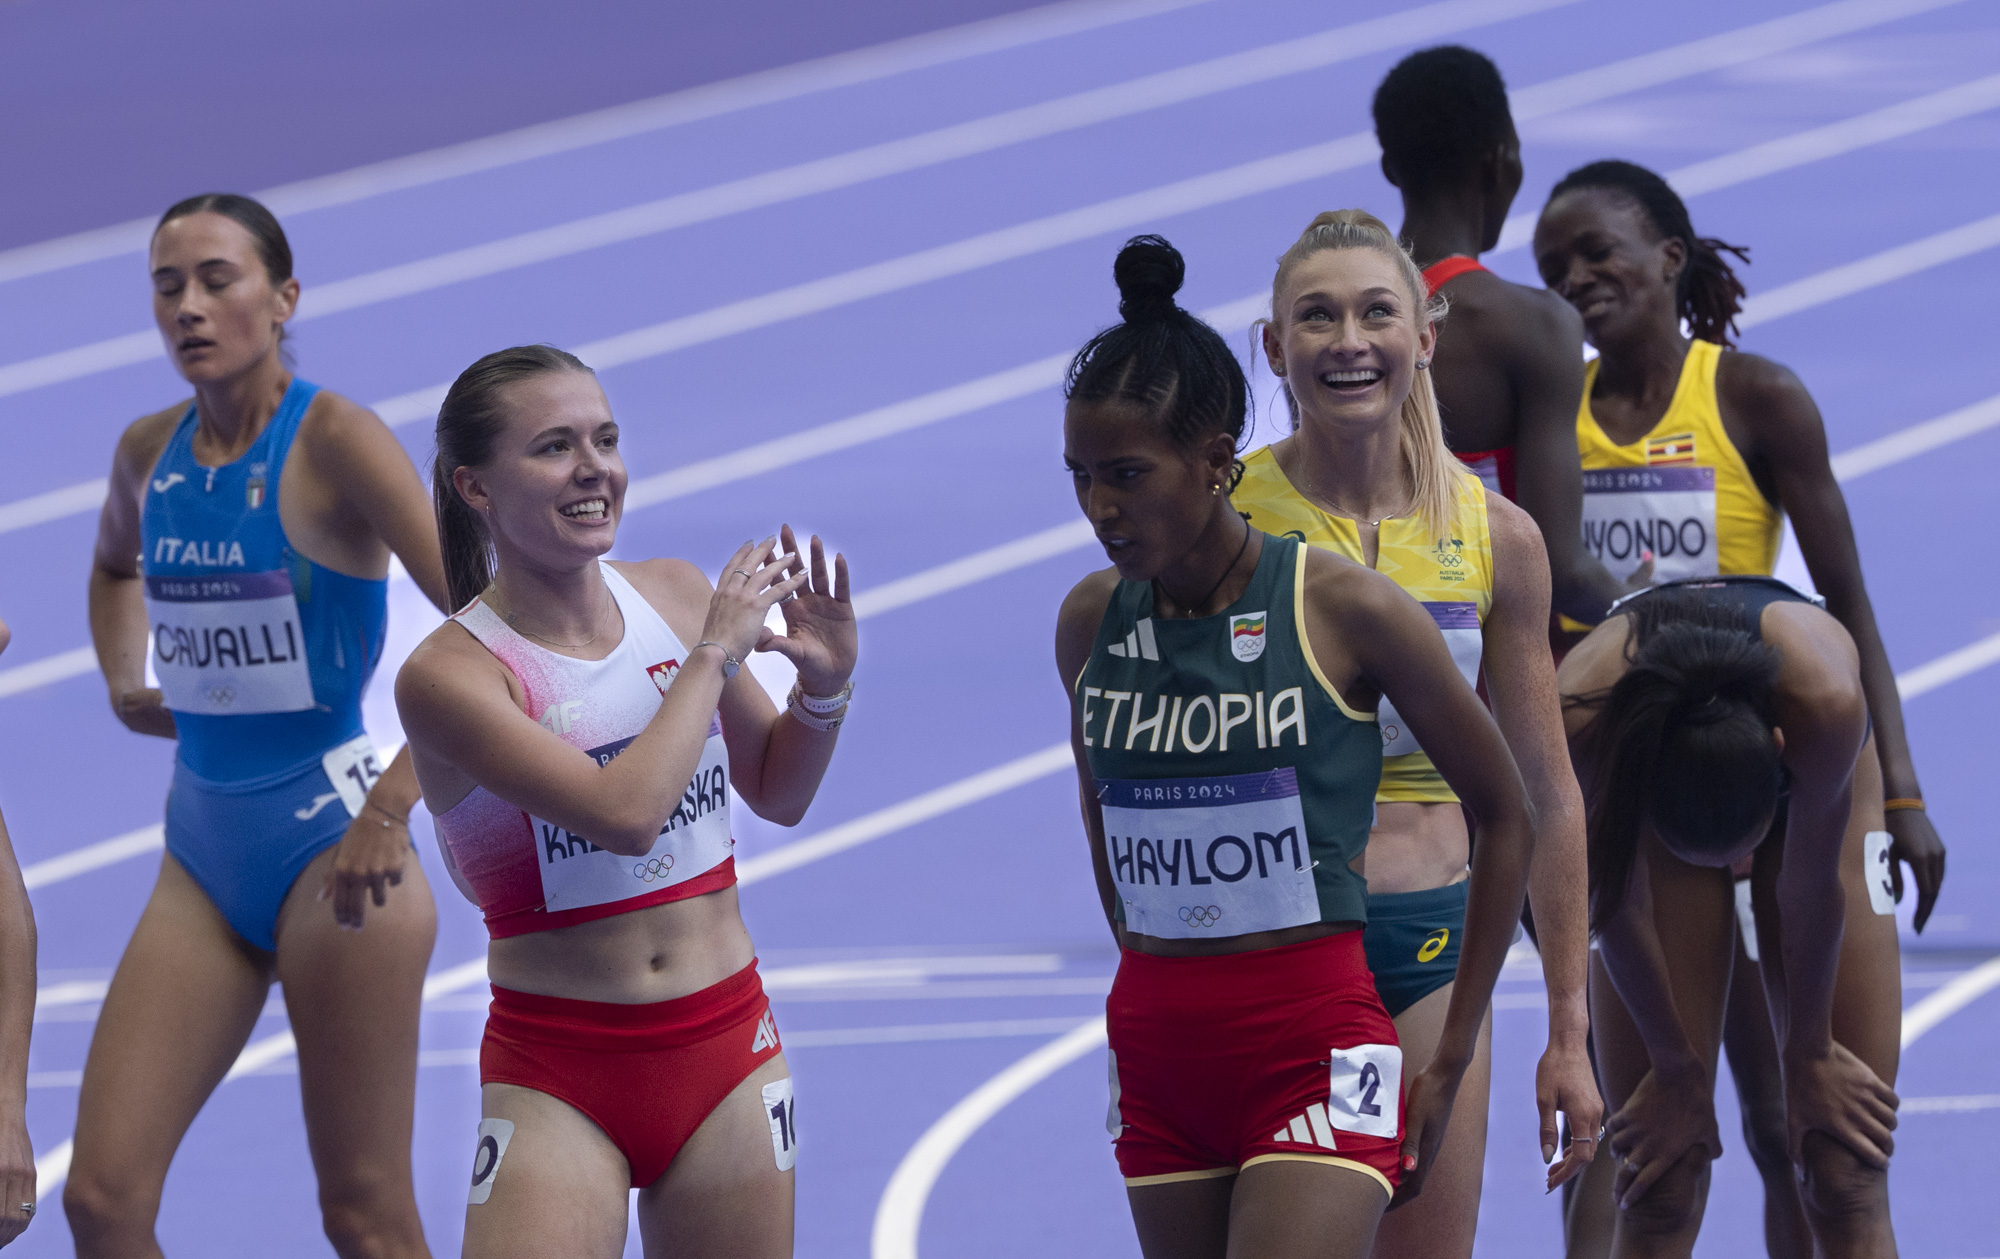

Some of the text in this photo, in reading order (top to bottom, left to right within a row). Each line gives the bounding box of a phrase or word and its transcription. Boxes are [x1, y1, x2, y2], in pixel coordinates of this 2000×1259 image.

[154, 537, 246, 567] ITALIA
[202, 581, 241, 597] 2024
[156, 621, 298, 669] CAVALLI
[1083, 686, 1307, 753] ETHIOPIA
[1188, 784, 1236, 799] 2024
[1111, 826, 1304, 887] HAYLOM
[1357, 1061, 1381, 1118] 2
